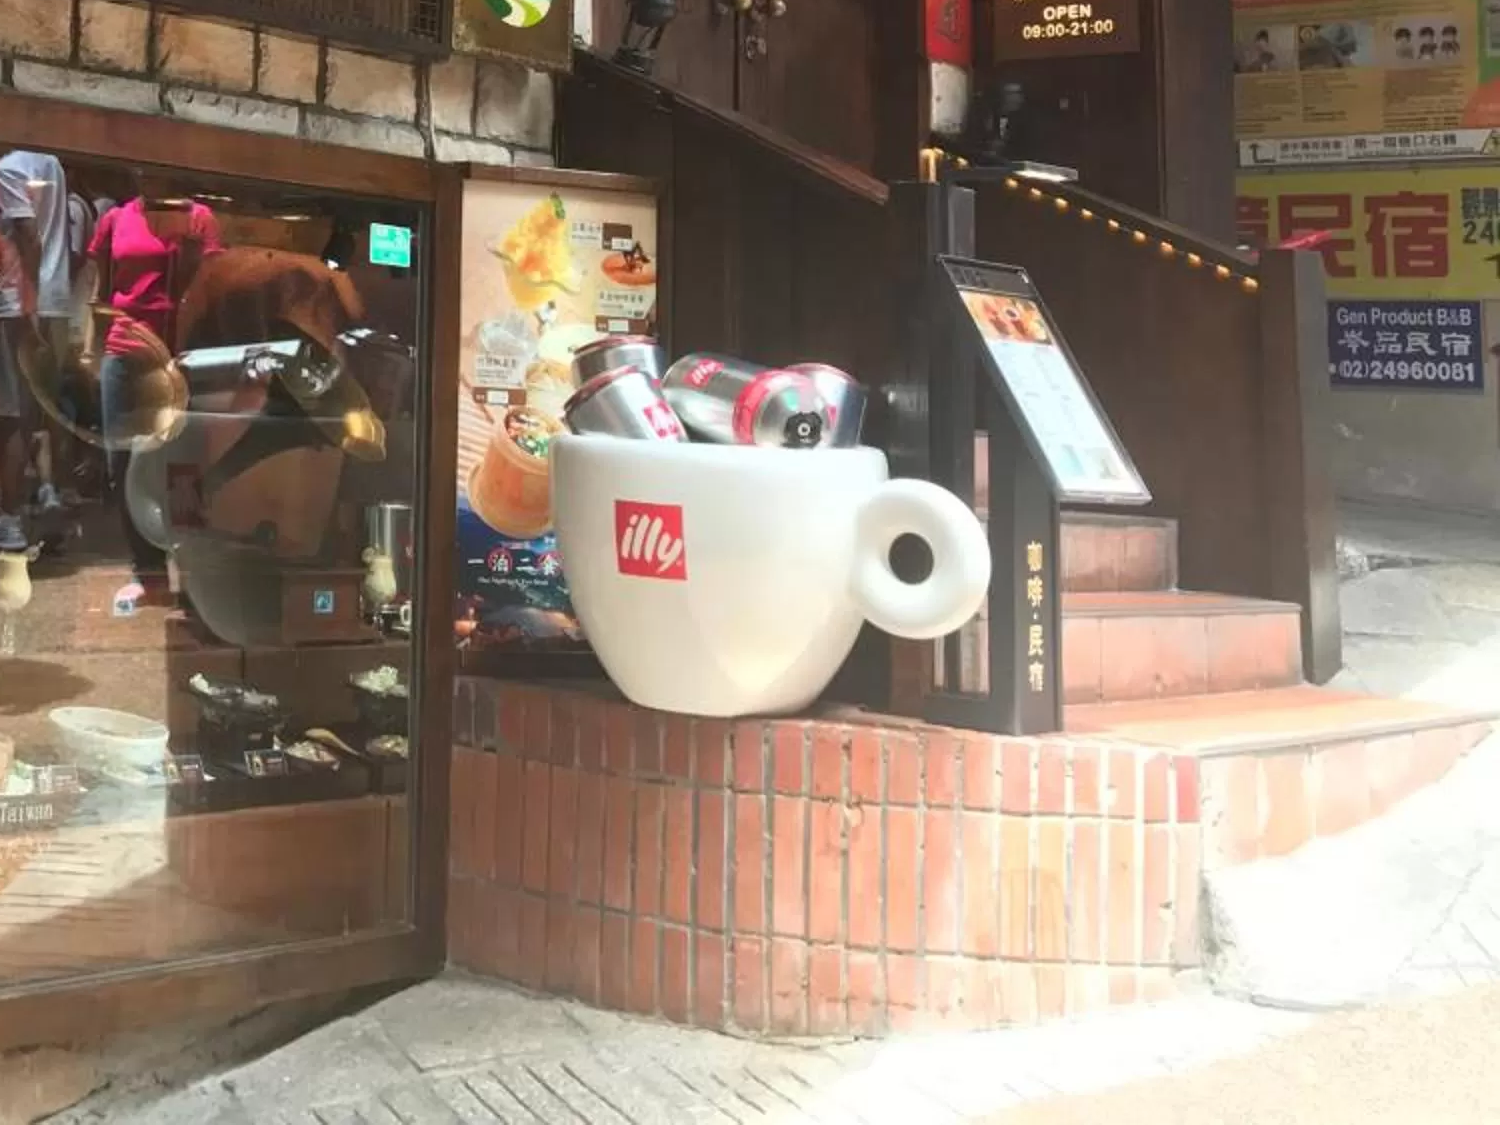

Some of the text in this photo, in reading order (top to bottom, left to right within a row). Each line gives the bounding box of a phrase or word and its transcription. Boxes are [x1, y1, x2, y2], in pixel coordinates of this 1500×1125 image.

[1043, 2, 1092, 21] OPEN
[1023, 18, 1113, 40] 09:00-21:00
[1462, 219, 1500, 246] 24
[1371, 307, 1434, 327] Product
[1437, 307, 1473, 327] B&B
[620, 514, 683, 574] illy
